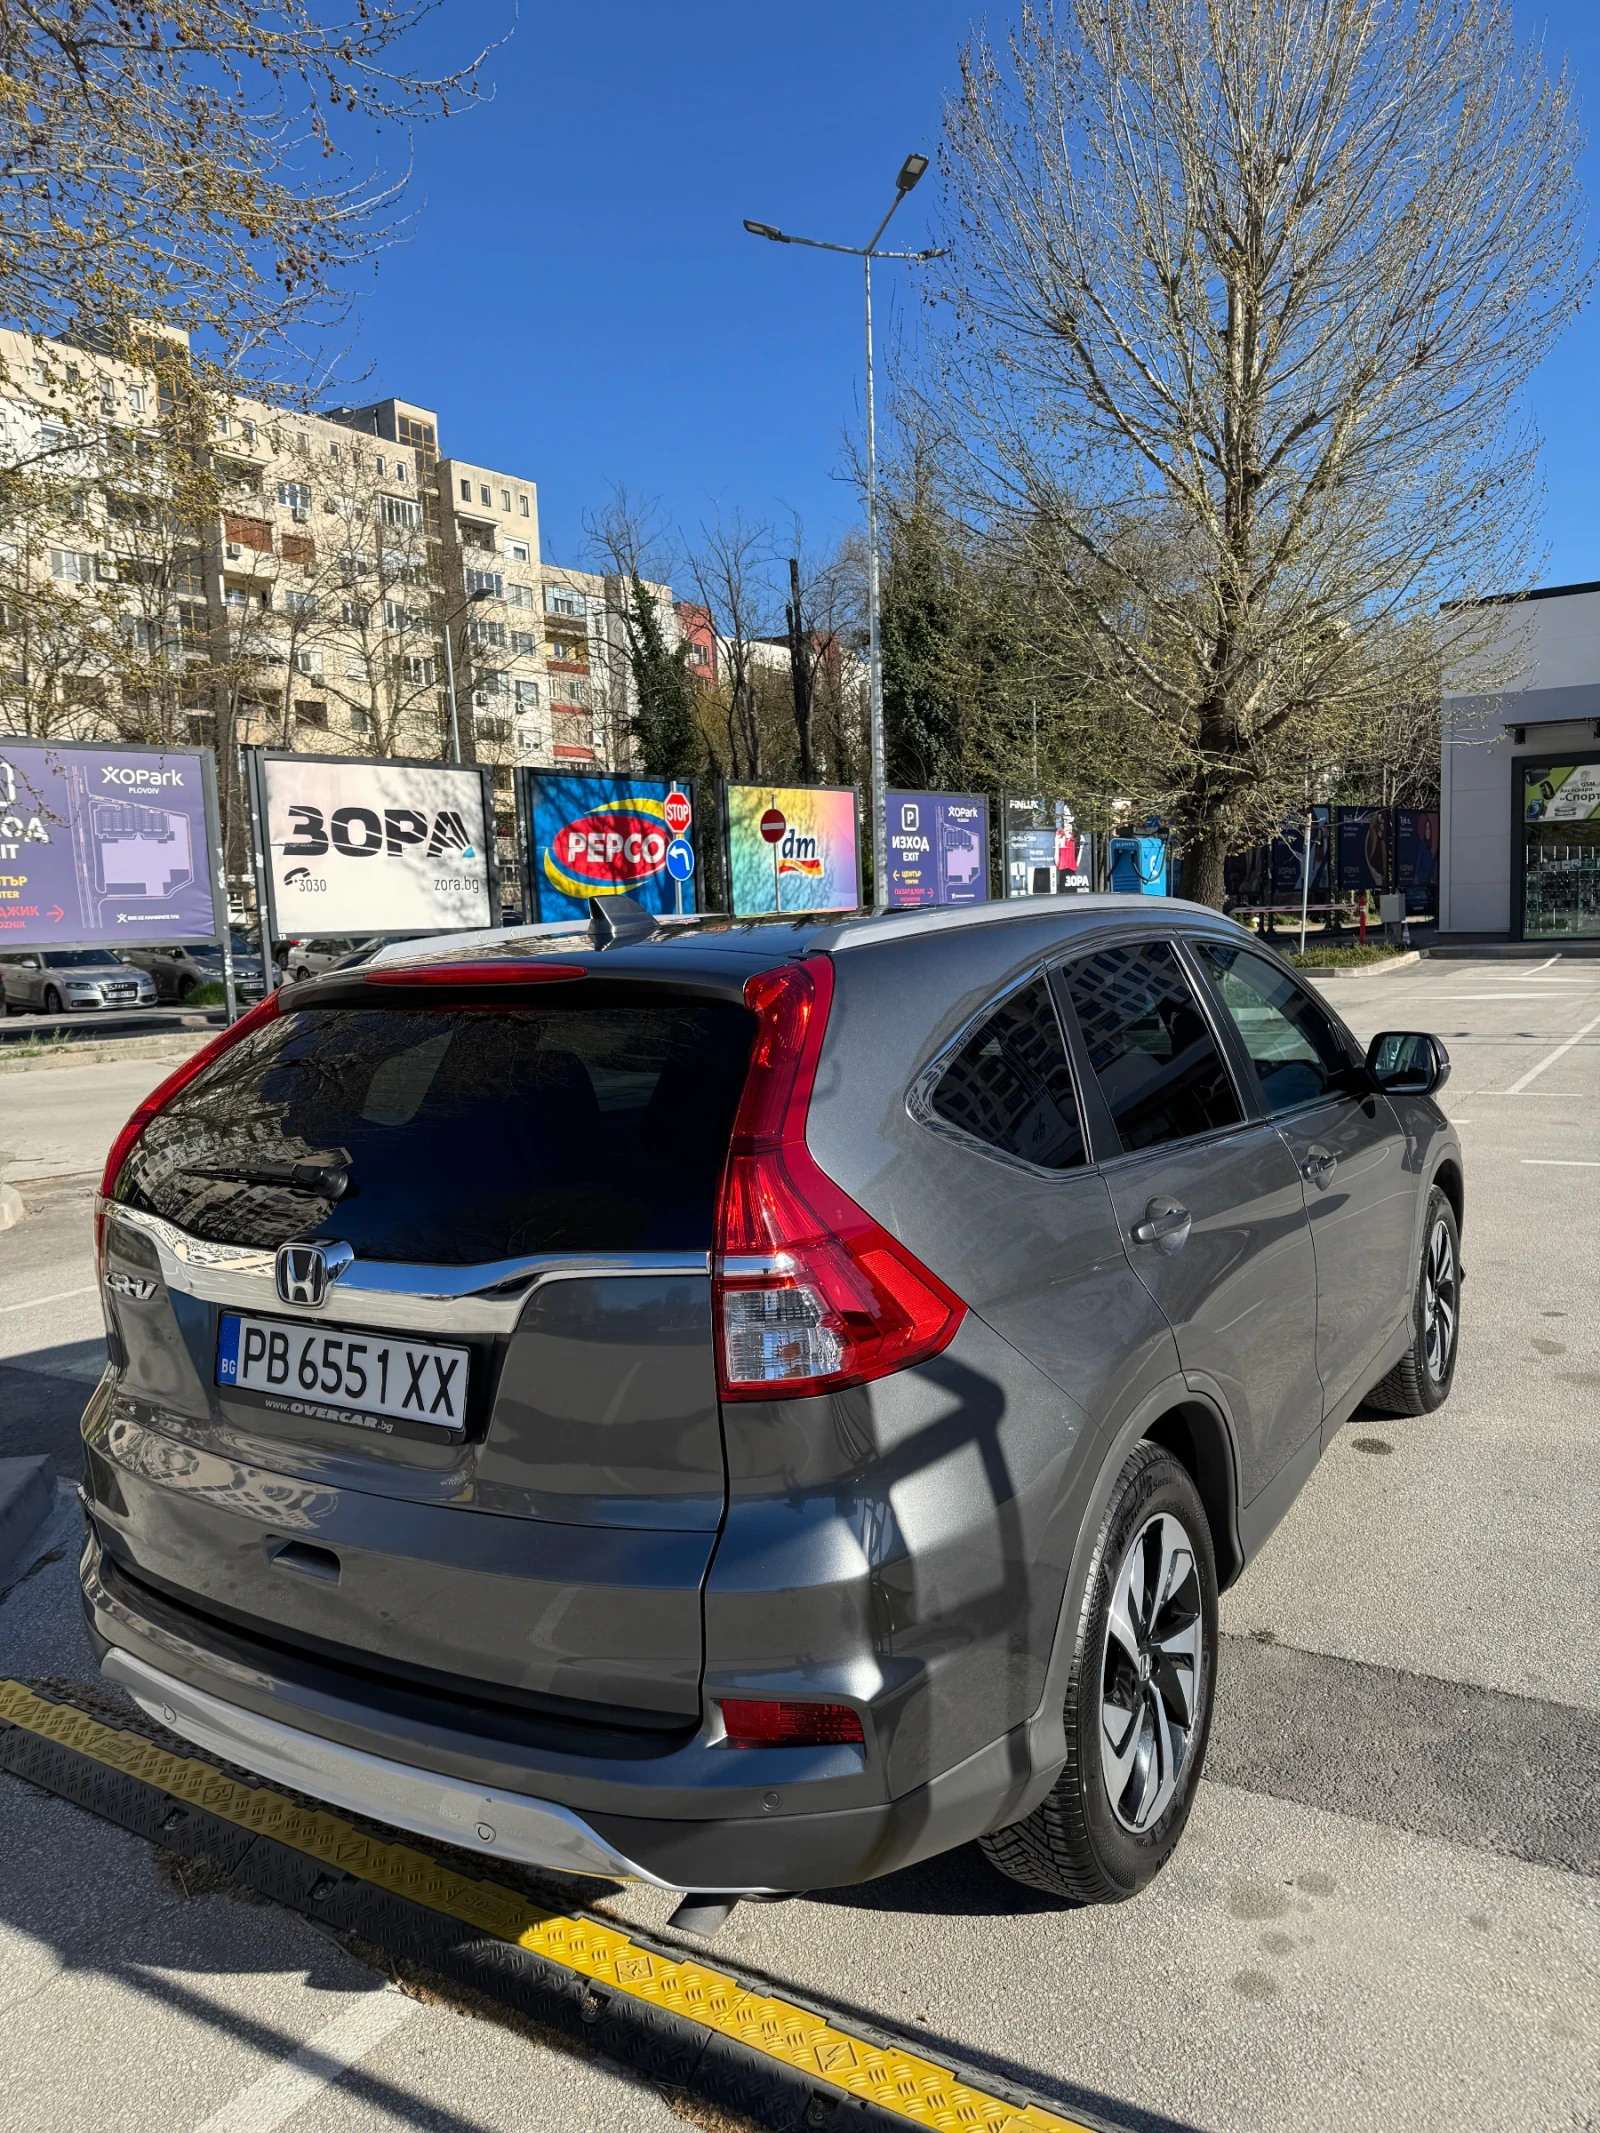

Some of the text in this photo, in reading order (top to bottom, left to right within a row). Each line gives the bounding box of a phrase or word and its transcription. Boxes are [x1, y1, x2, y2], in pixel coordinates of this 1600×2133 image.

[101, 766, 184, 787] XOPark
[128, 787, 160, 795] PLOVDIV
[665, 804, 690, 822] STOP
[948, 806, 979, 818] XOPark
[0, 816, 50, 843] ОД
[283, 805, 476, 858] ЗОРА
[567, 832, 666, 864] PEPCO
[782, 828, 816, 859] dm
[892, 836, 930, 852] ИЗХОД
[903, 852, 919, 861] EXIT
[298, 879, 327, 892] 3030
[434, 877, 479, 893] zora.bg
[1065, 875, 1090, 887] ЗОРА
[104, 1270, 159, 1300] CR-V
[221, 1357, 236, 1376] BG
[242, 1327, 459, 1417] PB 6551 XX
[265, 1399, 394, 1434] www.OVERCAR.bg
